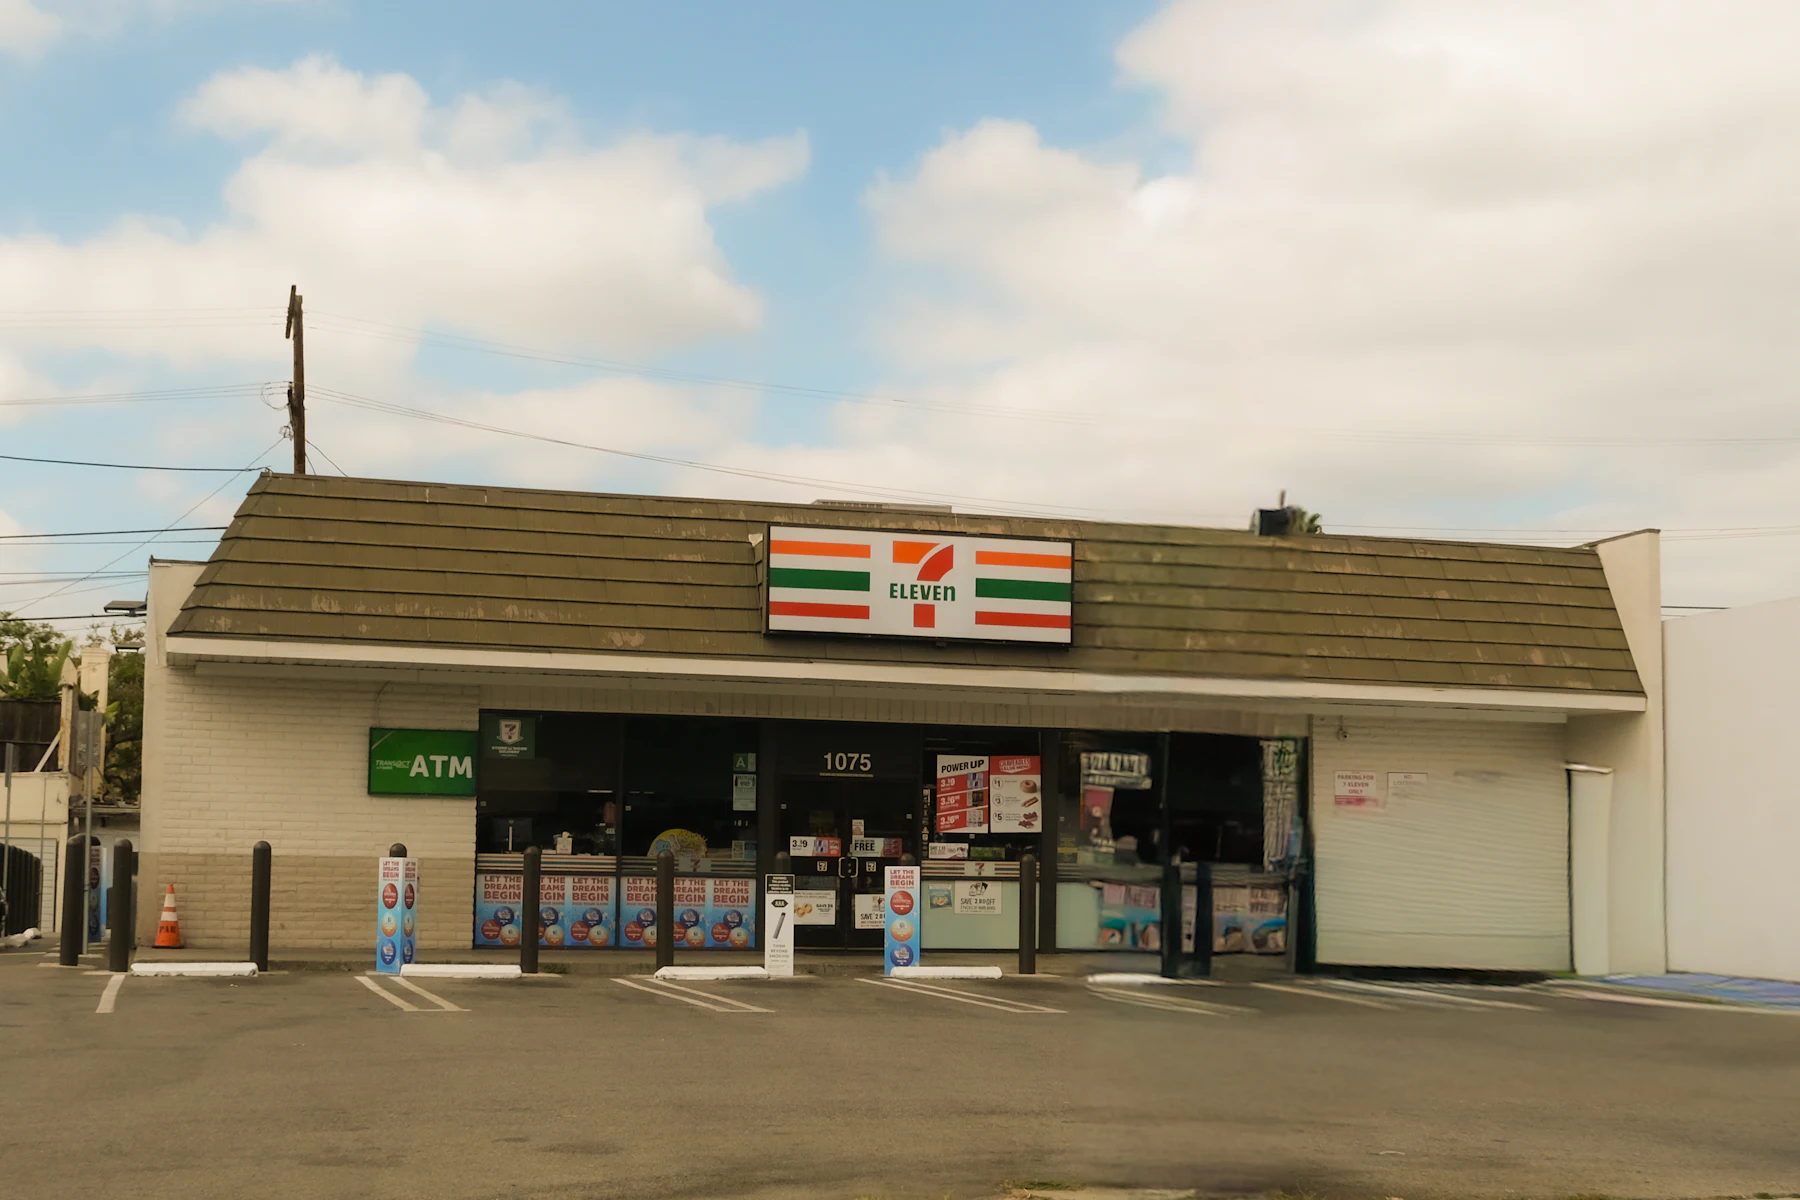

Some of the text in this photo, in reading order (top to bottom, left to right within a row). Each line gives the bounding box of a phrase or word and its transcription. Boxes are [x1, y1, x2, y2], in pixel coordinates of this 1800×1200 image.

[893, 540, 954, 629] 7
[736, 757, 745, 768] A
[824, 752, 872, 771] 1075
[409, 754, 473, 779] ATM
[942, 760, 984, 773] POWER UP
[854, 843, 875, 851] FREE
[484, 891, 521, 899] BEGIN
[540, 892, 565, 900] EGIN
[572, 892, 609, 901] BEGIN
[627, 893, 657, 901] BEGI
[713, 895, 749, 903] BEGIN
